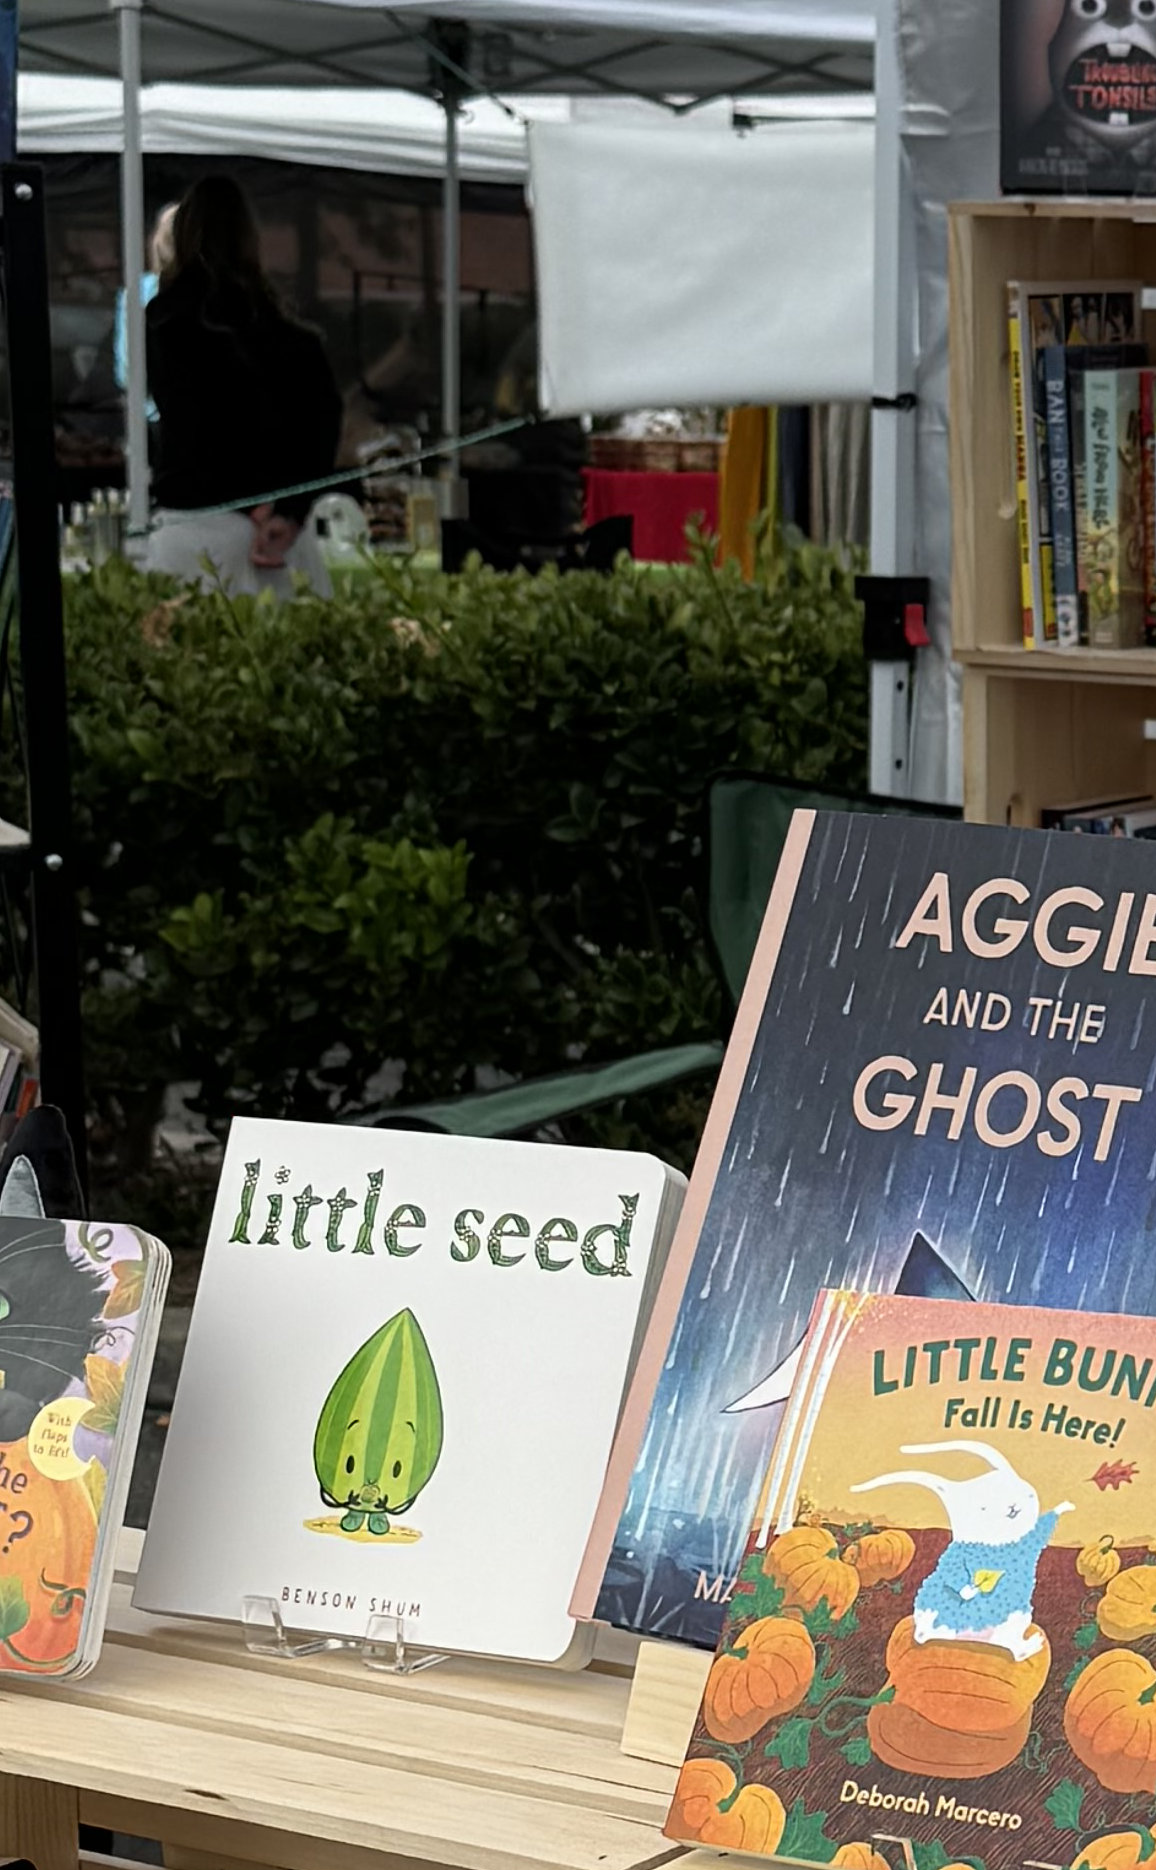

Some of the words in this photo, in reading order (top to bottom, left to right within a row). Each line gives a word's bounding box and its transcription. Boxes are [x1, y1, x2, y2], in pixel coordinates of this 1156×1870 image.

[923, 987, 1011, 1032] AND
[1030, 997, 1106, 1043] THE
[852, 1055, 1142, 1161] GHOST
[228, 1157, 427, 1258] little
[449, 1192, 640, 1279] seed
[872, 1336, 1032, 1396] LITTLE
[944, 1398, 999, 1430] Fall
[1009, 1400, 1033, 1430] Is
[1042, 1405, 1126, 1448] Here!
[280, 1585, 357, 1610] BENSON
[370, 1596, 421, 1618] SHUM
[840, 1780, 930, 1817] Deborah
[935, 1796, 1022, 1831] Marcero
